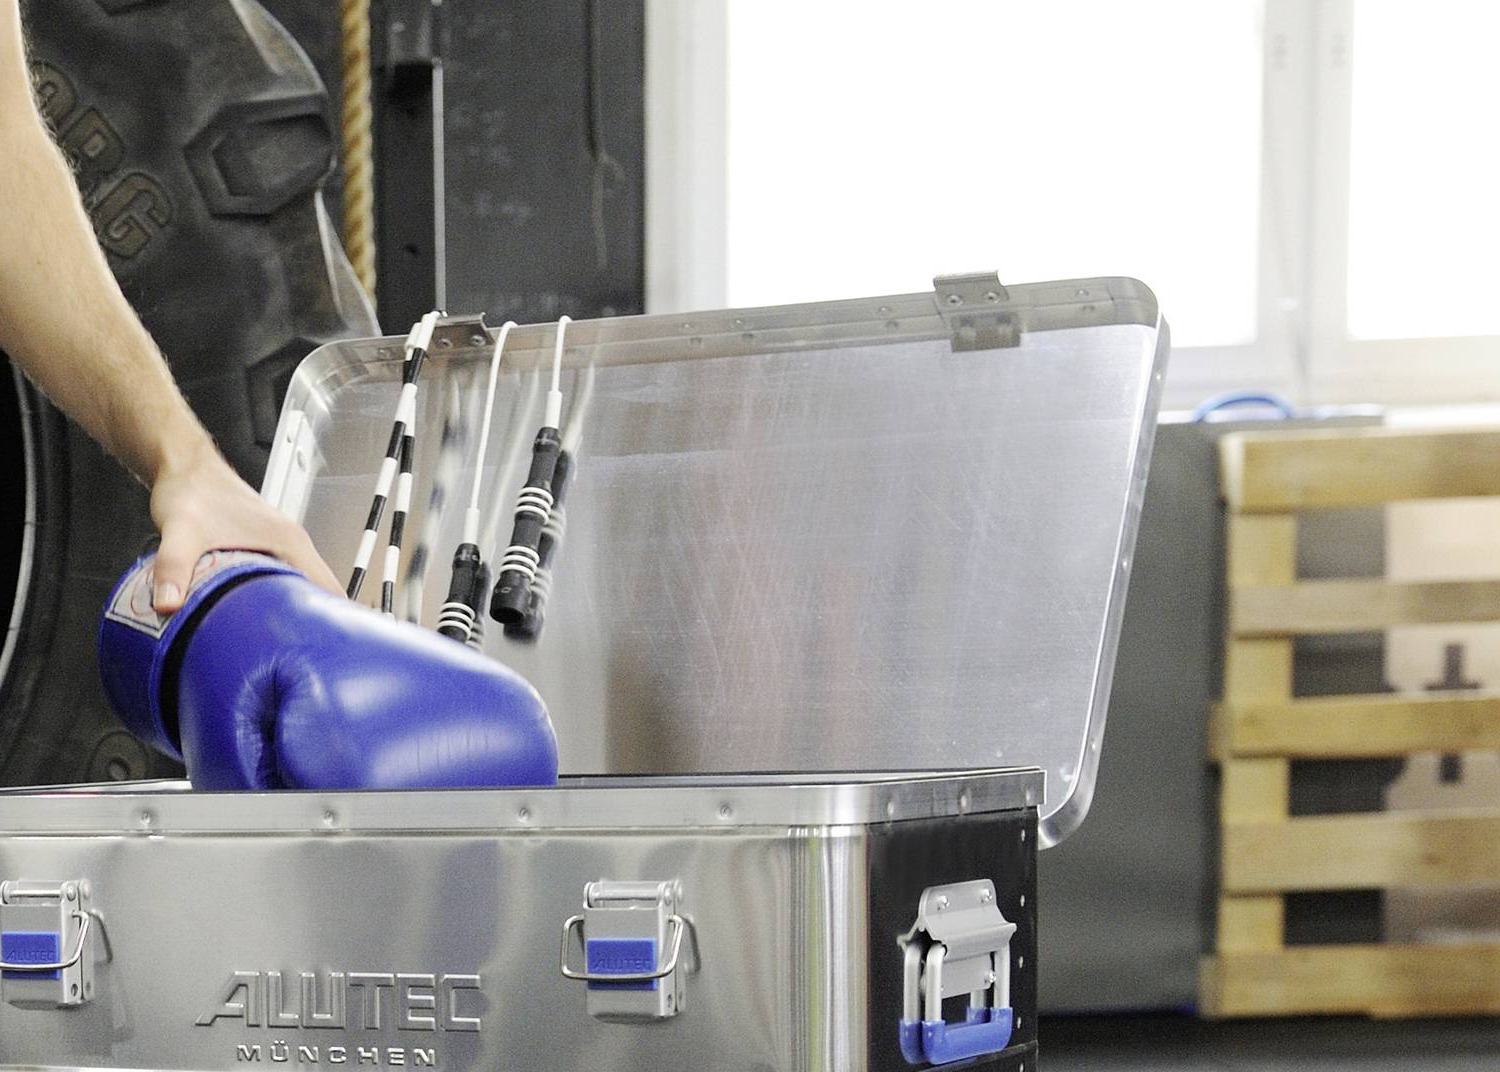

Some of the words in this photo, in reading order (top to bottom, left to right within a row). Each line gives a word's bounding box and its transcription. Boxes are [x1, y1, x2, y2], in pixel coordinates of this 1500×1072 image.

[5, 949, 55, 963] ALUTEC
[194, 969, 482, 1033] ALUTEC
[236, 1039, 436, 1067] MÜNCHEN
